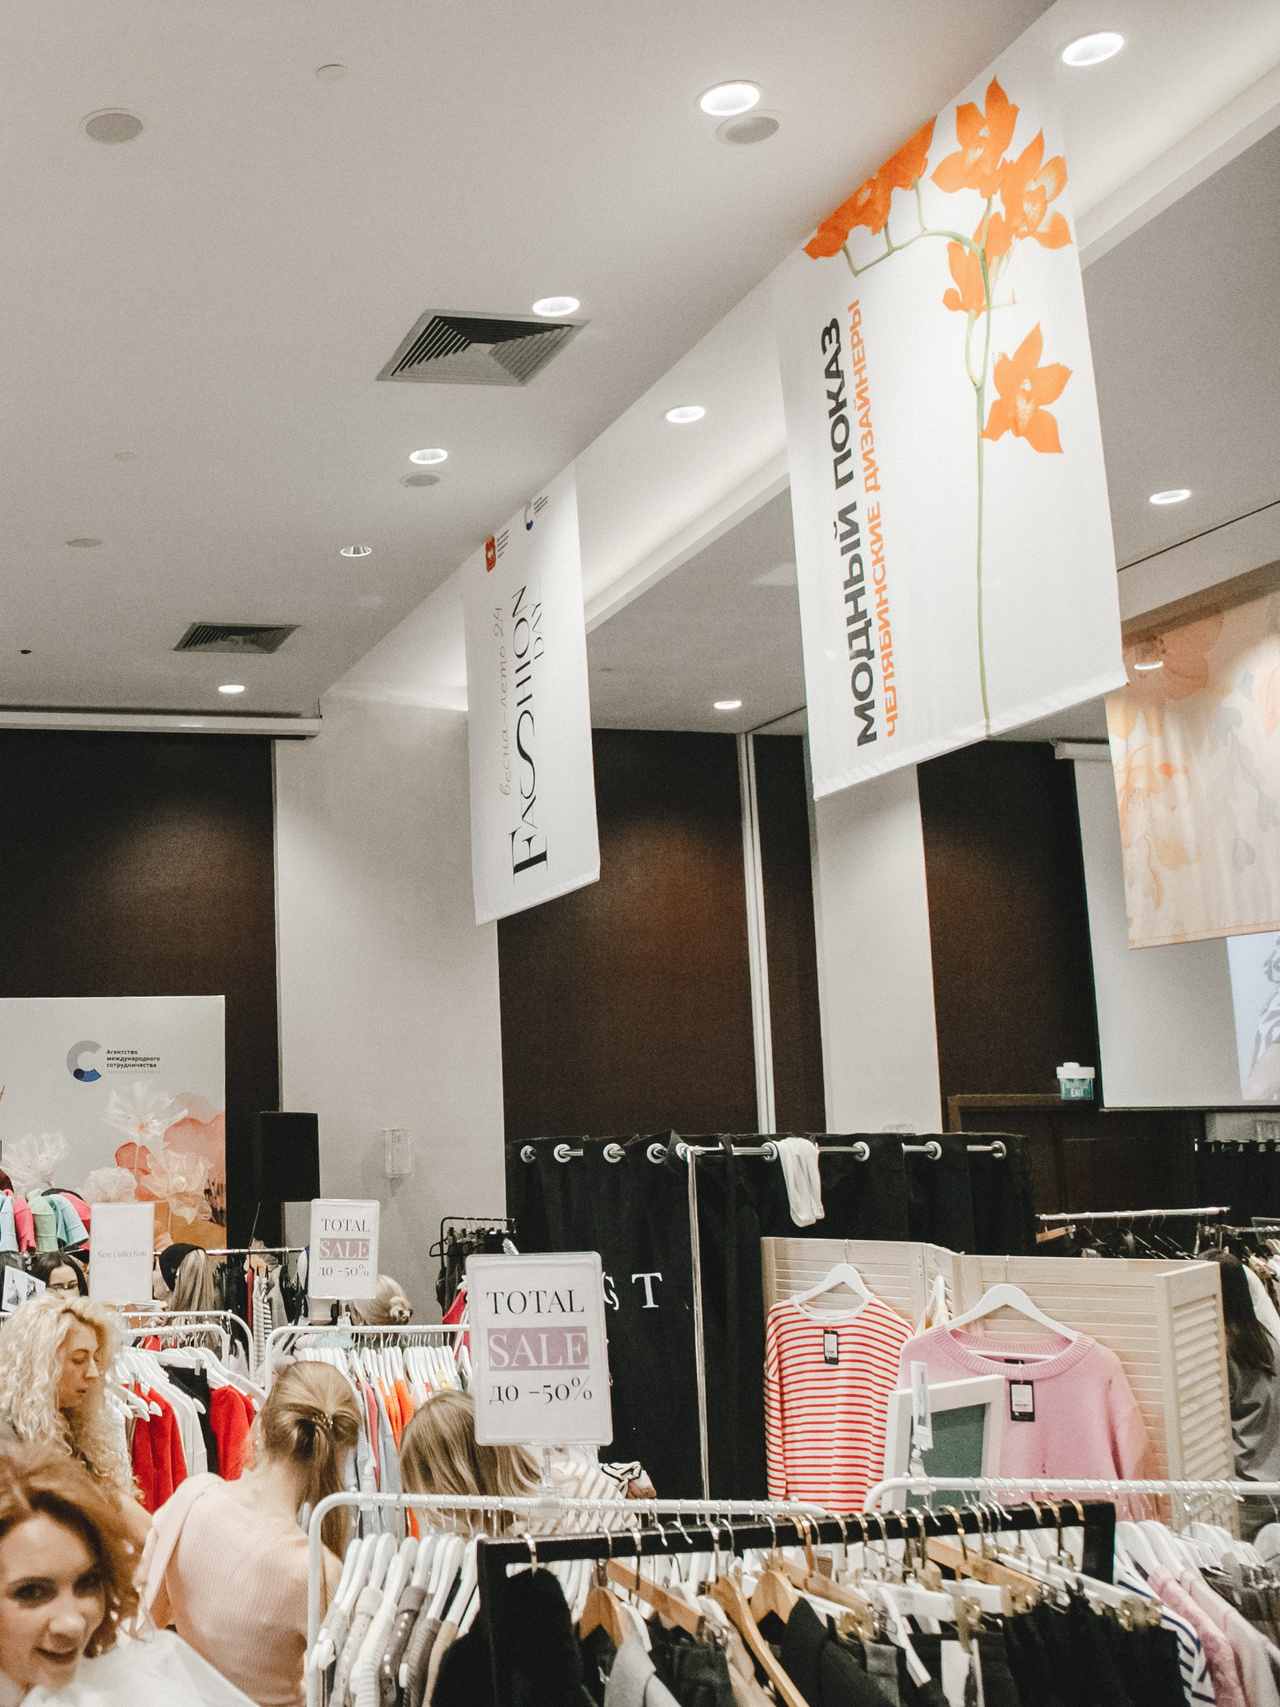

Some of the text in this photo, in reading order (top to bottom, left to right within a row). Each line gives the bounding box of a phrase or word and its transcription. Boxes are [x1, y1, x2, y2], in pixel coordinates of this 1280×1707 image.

[821, 318, 877, 747] МОДНЫЙ ПОКАЗ
[848, 299, 898, 737] ЧЕЛЯБИНСКИЕ ДИЗАЙНЕРЫ
[493, 607, 503, 637] 24
[531, 590, 545, 660] DAY
[509, 585, 549, 884] FASHION
[321, 1218, 370, 1232] TOTAL
[320, 1240, 369, 1259] SALE
[318, 1264, 369, 1278] до -50%
[486, 1289, 585, 1314] TOTAL
[488, 1332, 589, 1368] SALE
[489, 1375, 593, 1405] до -50%
